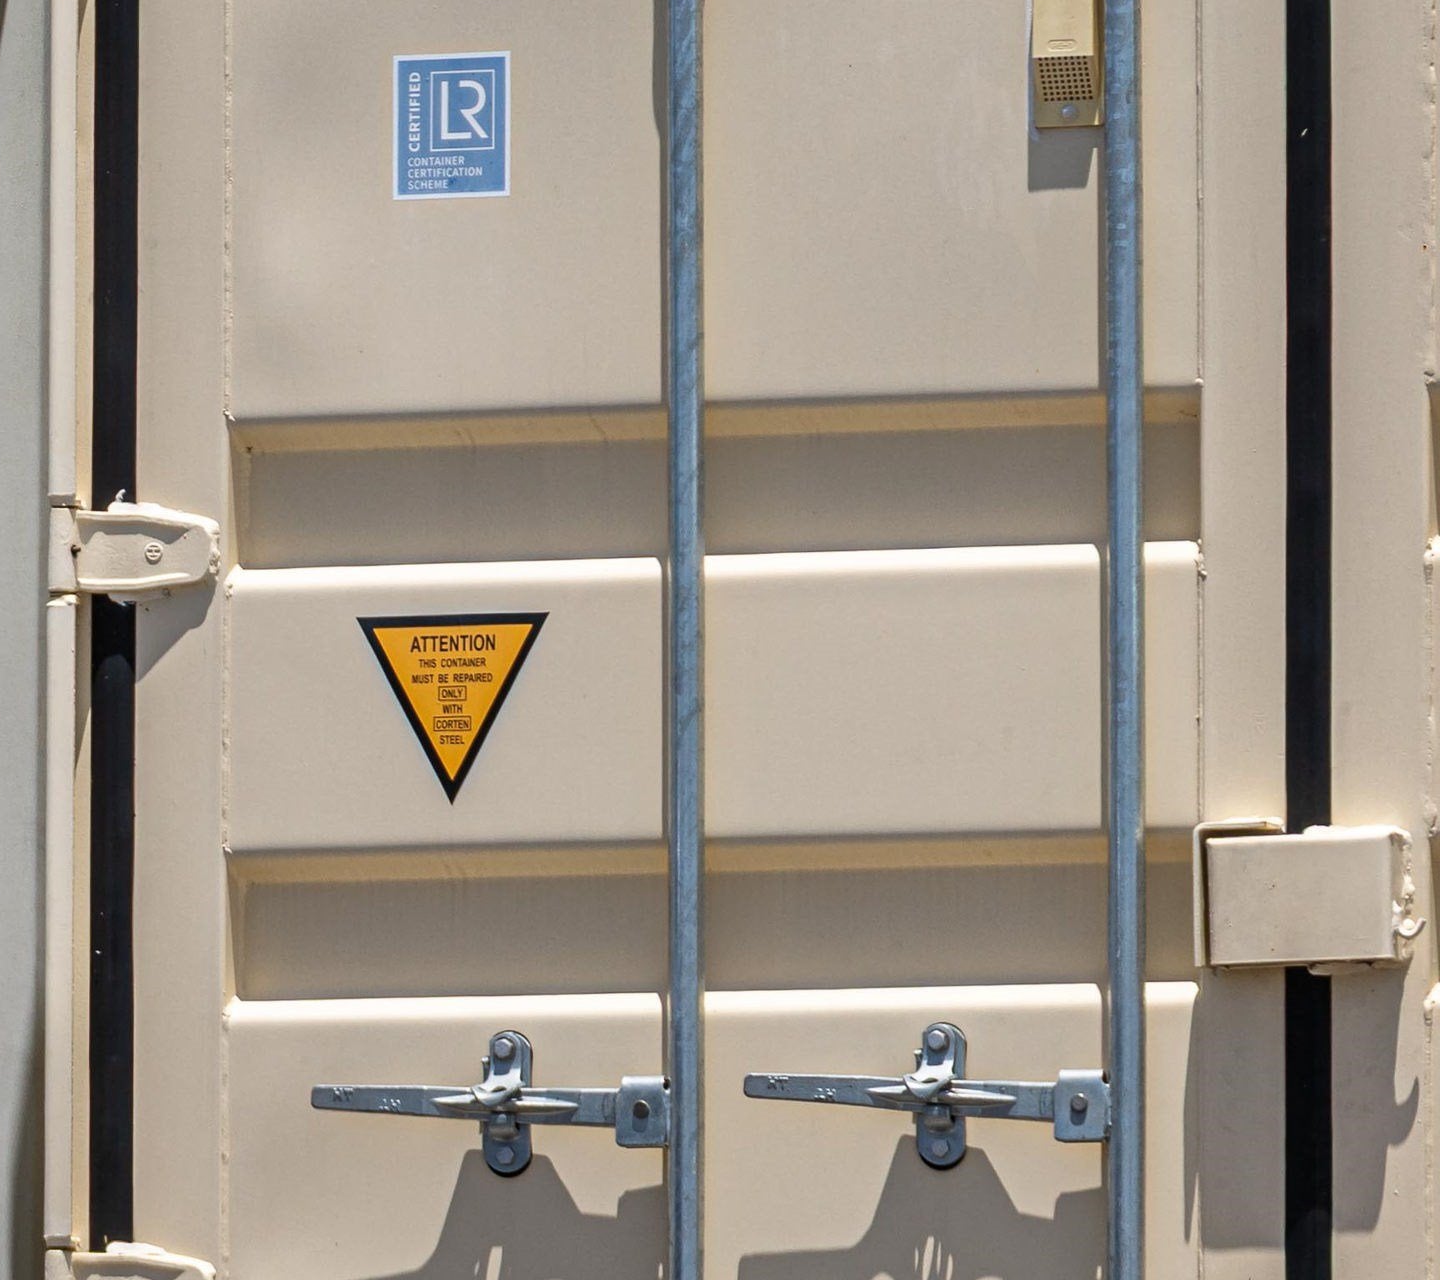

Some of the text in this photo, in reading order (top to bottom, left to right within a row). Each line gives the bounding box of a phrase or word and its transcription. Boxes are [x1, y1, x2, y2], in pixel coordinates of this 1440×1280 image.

[409, 72, 421, 152] CERTIFIED
[441, 79, 488, 140] LR
[408, 156, 465, 167] CONTAINER
[408, 166, 483, 178] CERTIFICATION
[407, 179, 449, 190] SCHEME
[410, 634, 496, 653] ATTENTION
[418, 657, 487, 668] THIS CONTAINER
[411, 672, 493, 684] MUST BE REPAIRED
[441, 688, 464, 699] ONLY
[442, 704, 463, 714] WITH
[435, 719, 470, 729] CORTEN
[439, 735, 465, 745] STEEL
